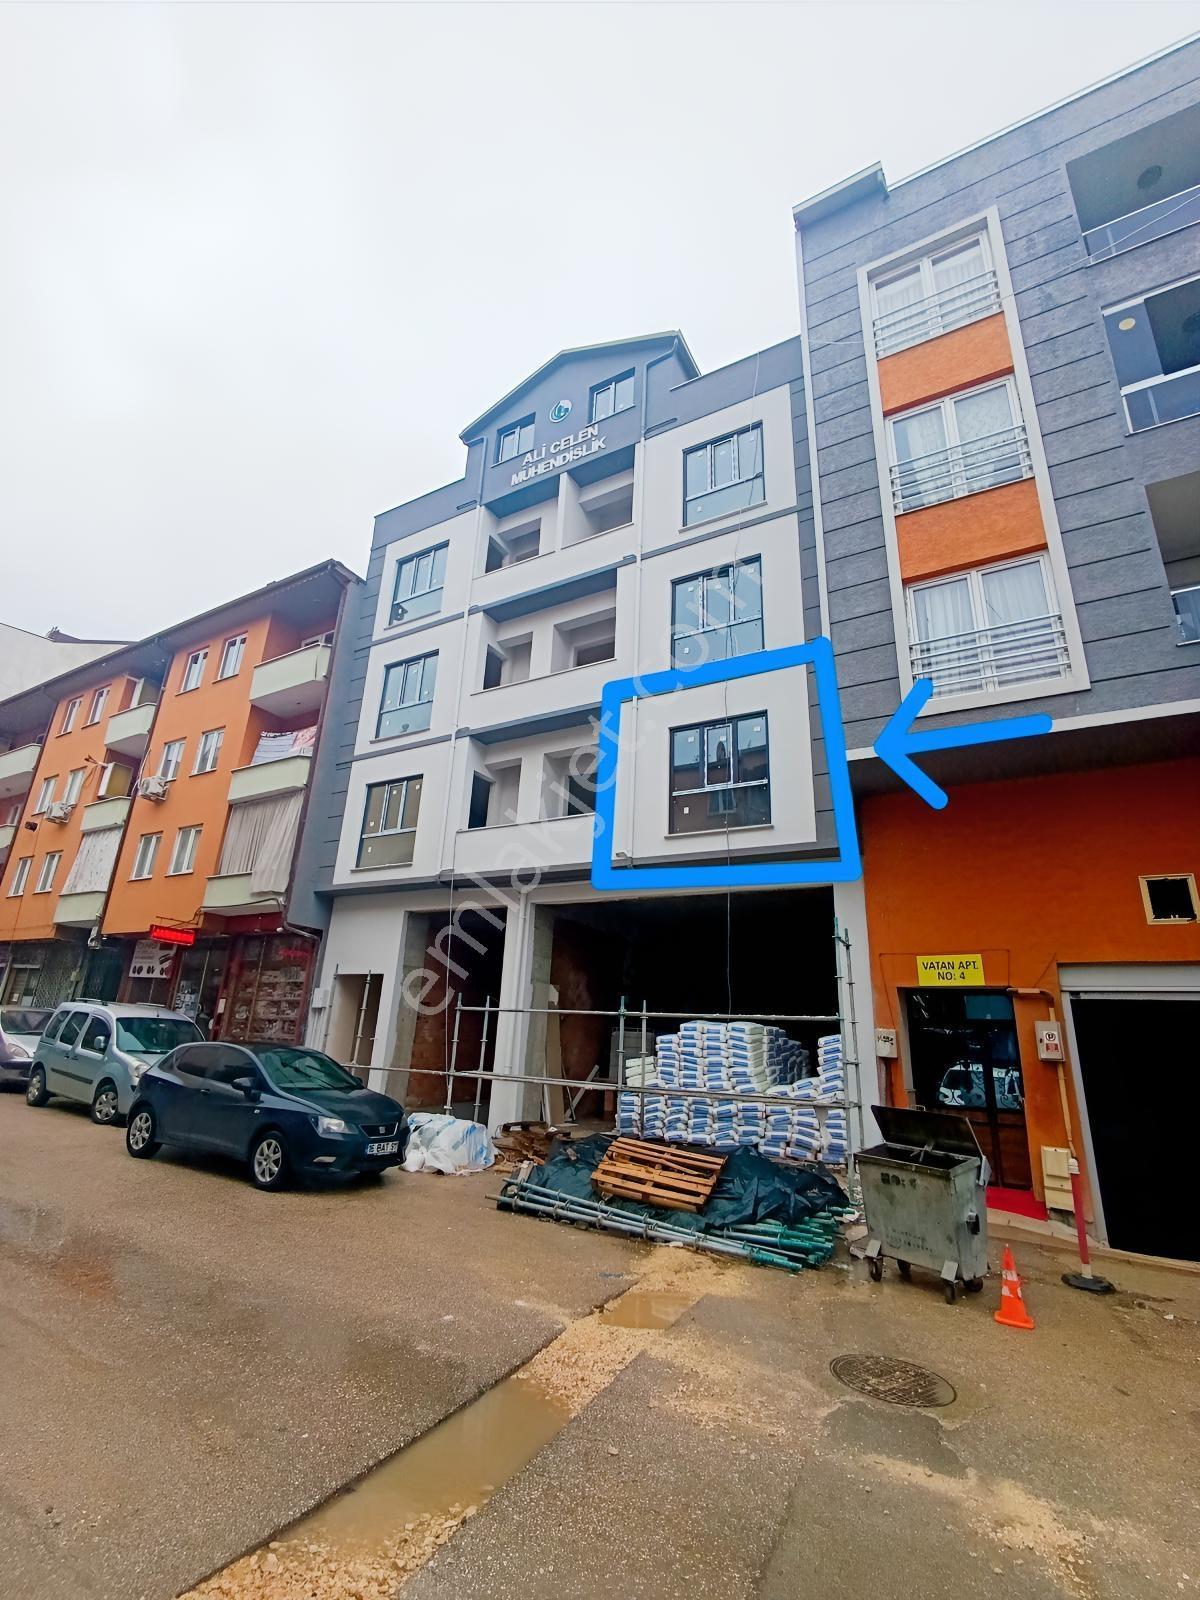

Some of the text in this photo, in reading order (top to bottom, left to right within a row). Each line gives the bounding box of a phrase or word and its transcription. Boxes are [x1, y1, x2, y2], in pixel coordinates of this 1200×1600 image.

[510, 436, 607, 486] MÜHENDİSLİK
[522, 443, 547, 467] ALİ
[922, 961, 955, 970] VATAN
[937, 971, 966, 980] NO: 4
